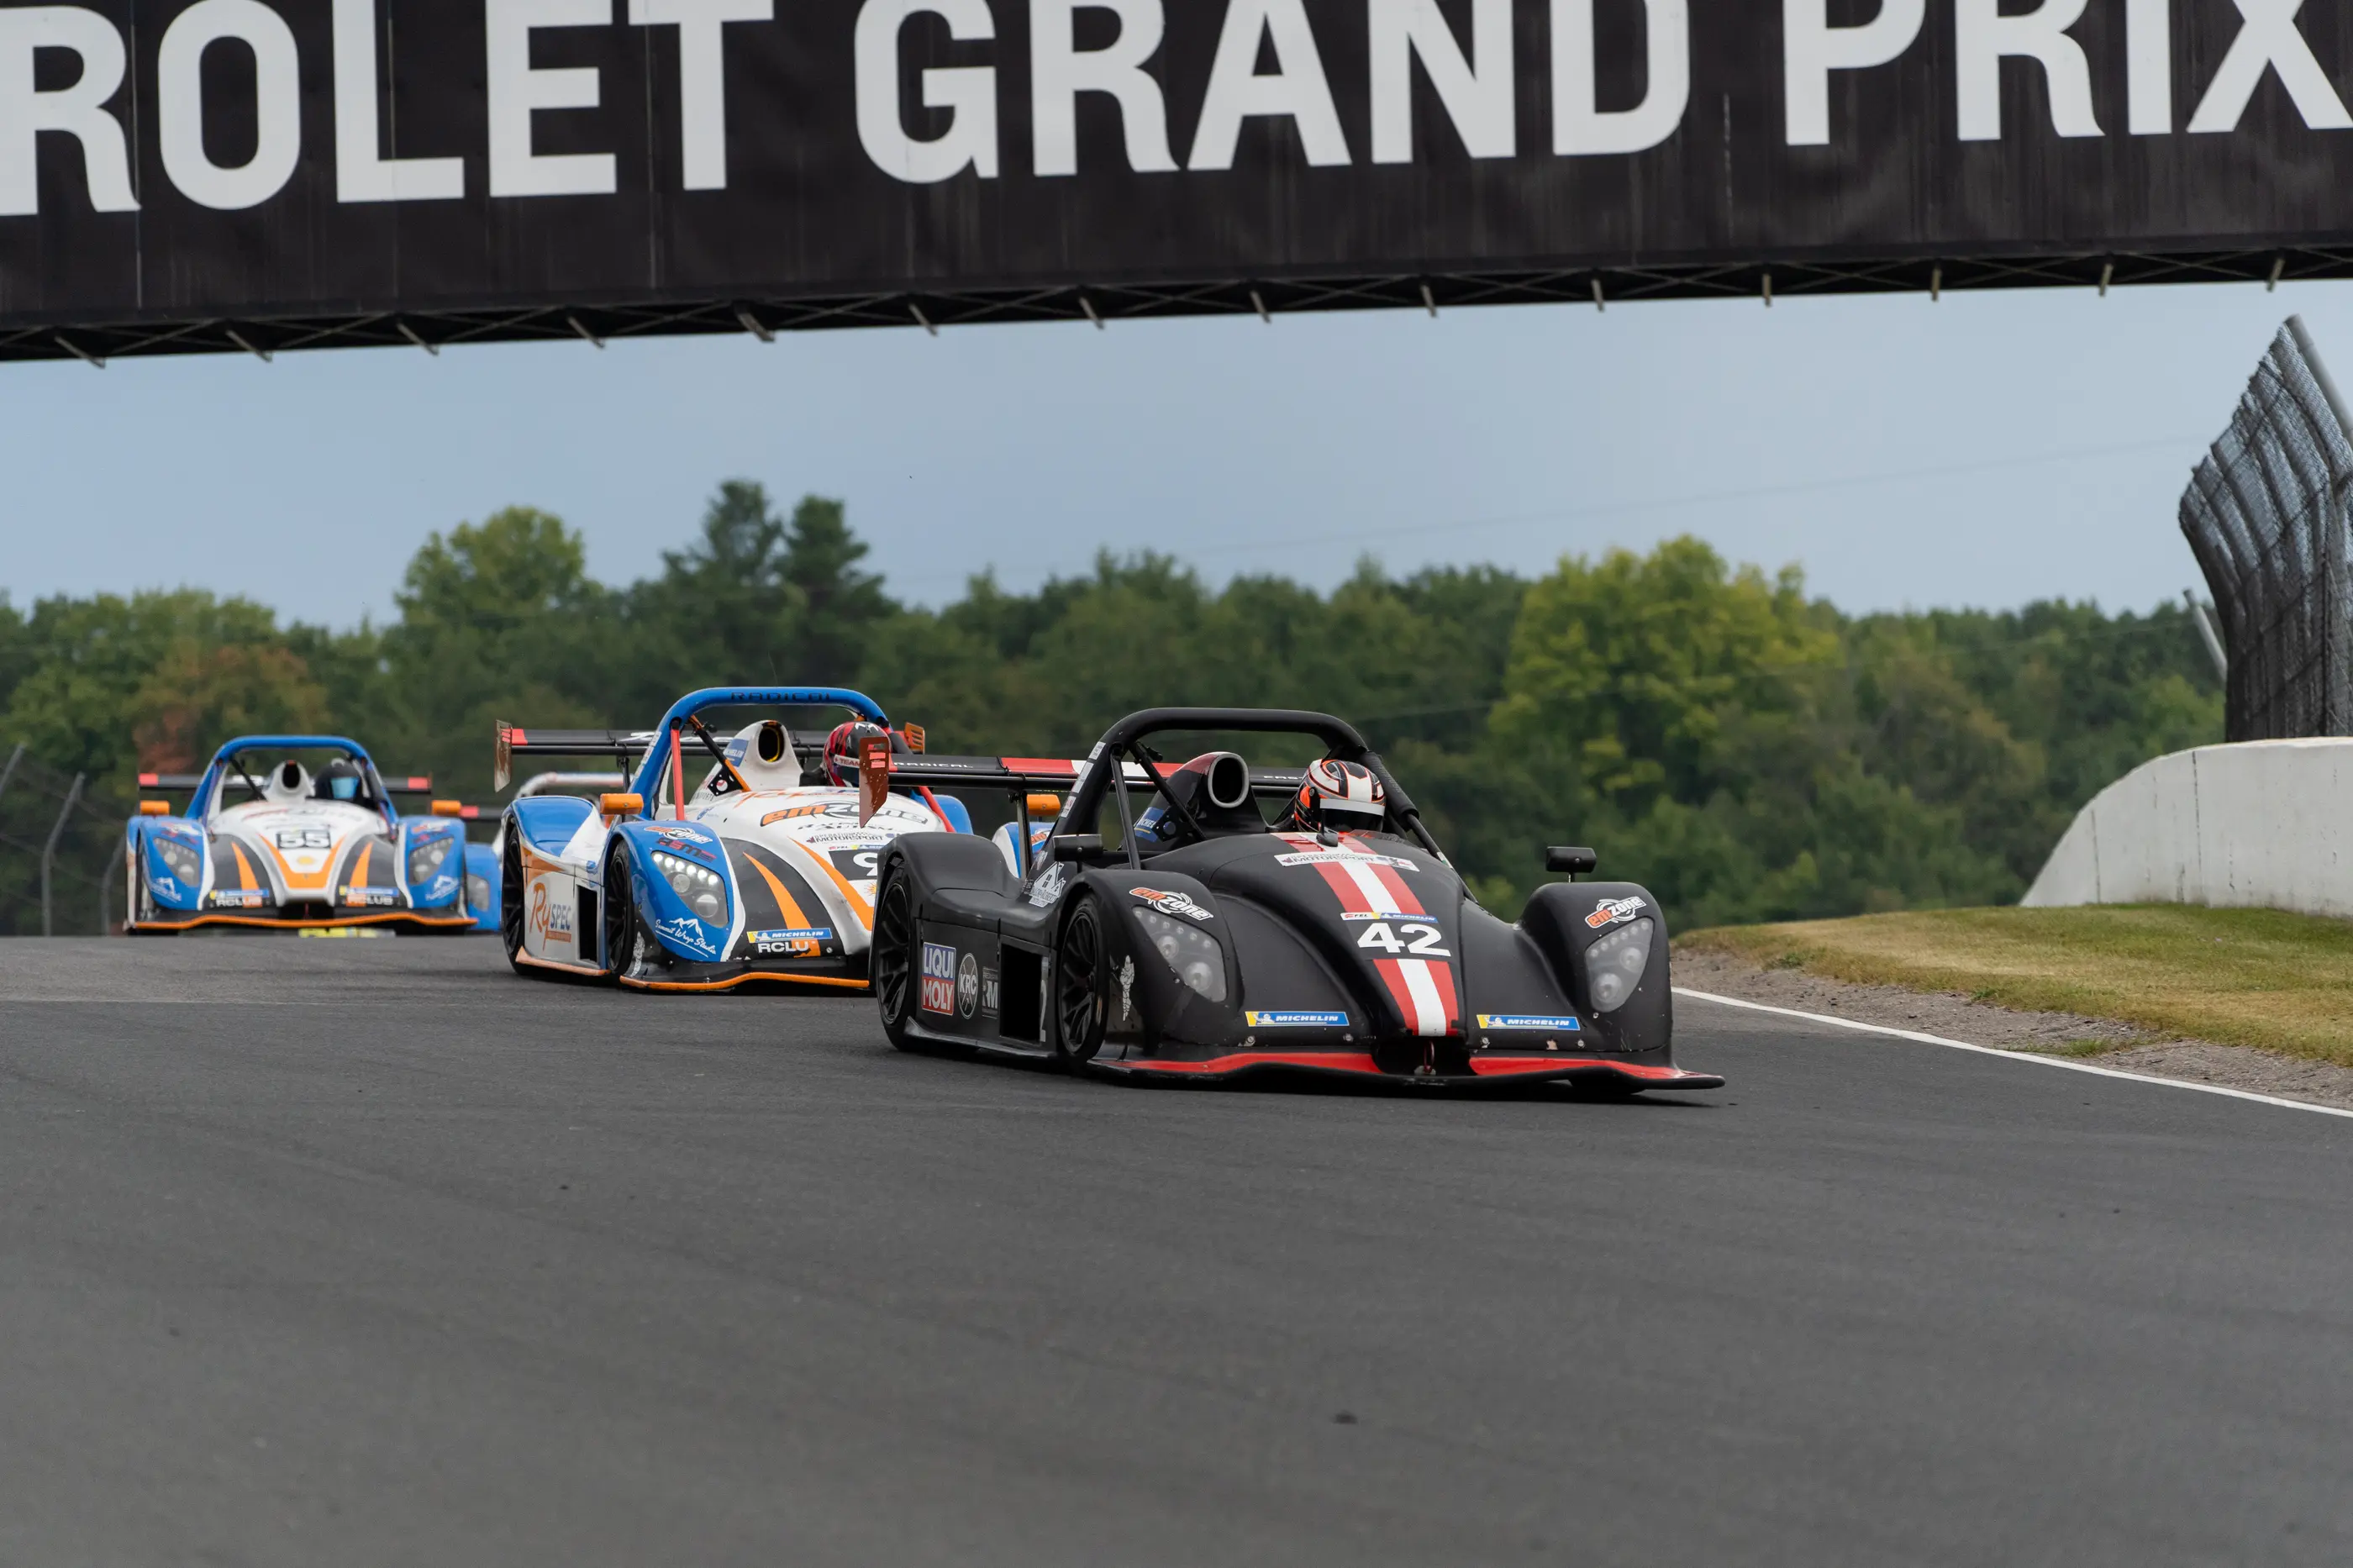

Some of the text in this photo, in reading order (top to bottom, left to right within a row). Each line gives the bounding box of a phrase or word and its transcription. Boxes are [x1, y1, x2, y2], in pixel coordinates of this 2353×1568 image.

[0, 0, 2353, 216] ROLET GRAND PRIX
[730, 692, 831, 701] RADICAL
[760, 803, 929, 827] emzne
[278, 830, 329, 848] 55
[1132, 887, 1213, 921] emzone
[1586, 897, 1646, 929] emzone
[1392, 913, 1436, 922] MICHELIN
[771, 930, 824, 939] MICHELIN
[1356, 923, 1452, 957] 42
[924, 946, 955, 979] LIQUI
[923, 979, 955, 1011] MOLY
[960, 973, 977, 996] KRC
[1275, 1014, 1339, 1023] MICHELIN
